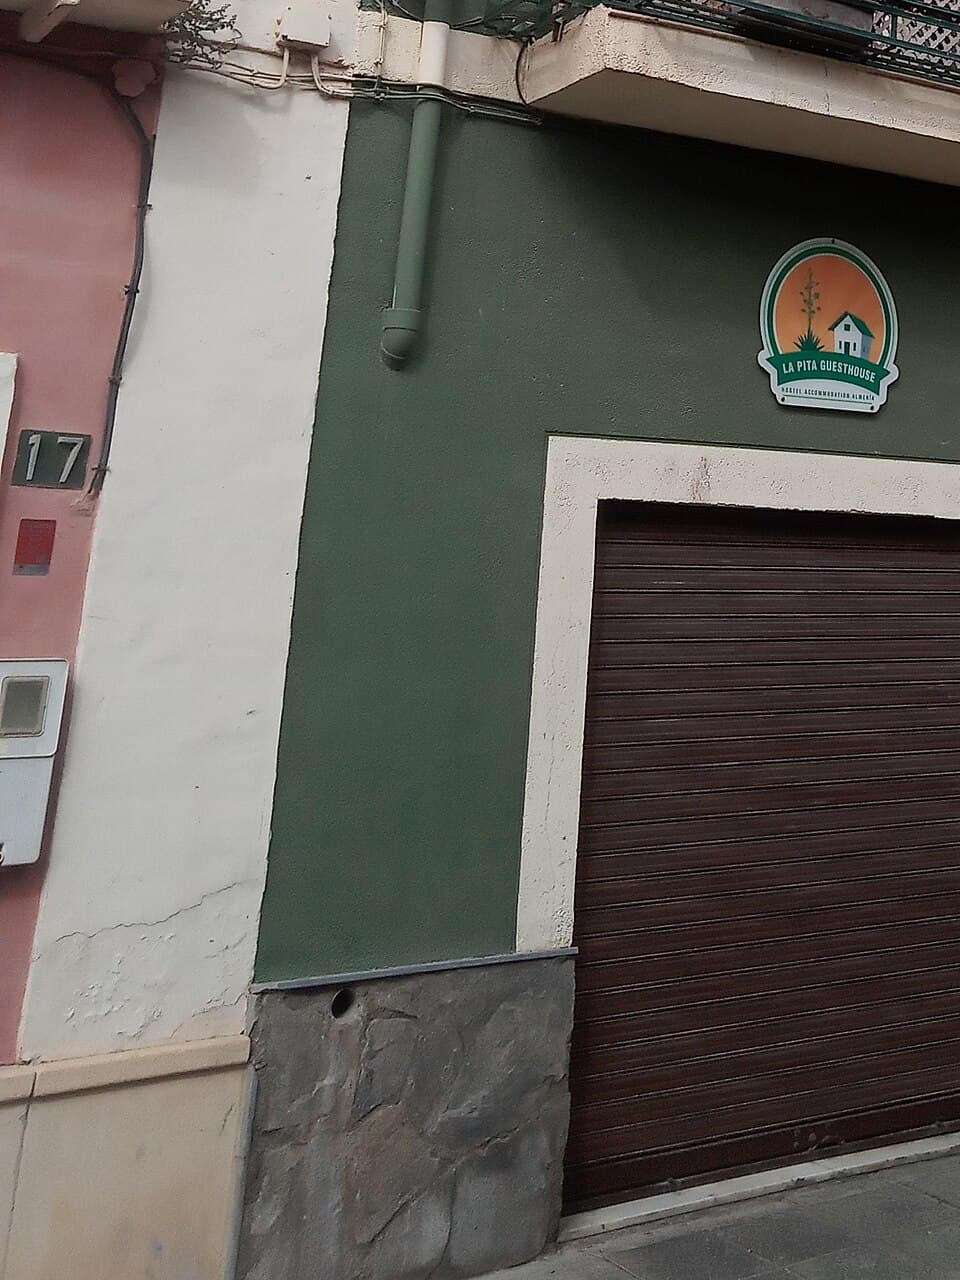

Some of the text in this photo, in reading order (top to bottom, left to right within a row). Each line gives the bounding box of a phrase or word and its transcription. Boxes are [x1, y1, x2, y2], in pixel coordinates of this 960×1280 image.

[782, 359, 876, 383] LA PITA GUESTHOUSE
[26, 434, 84, 483] 17
